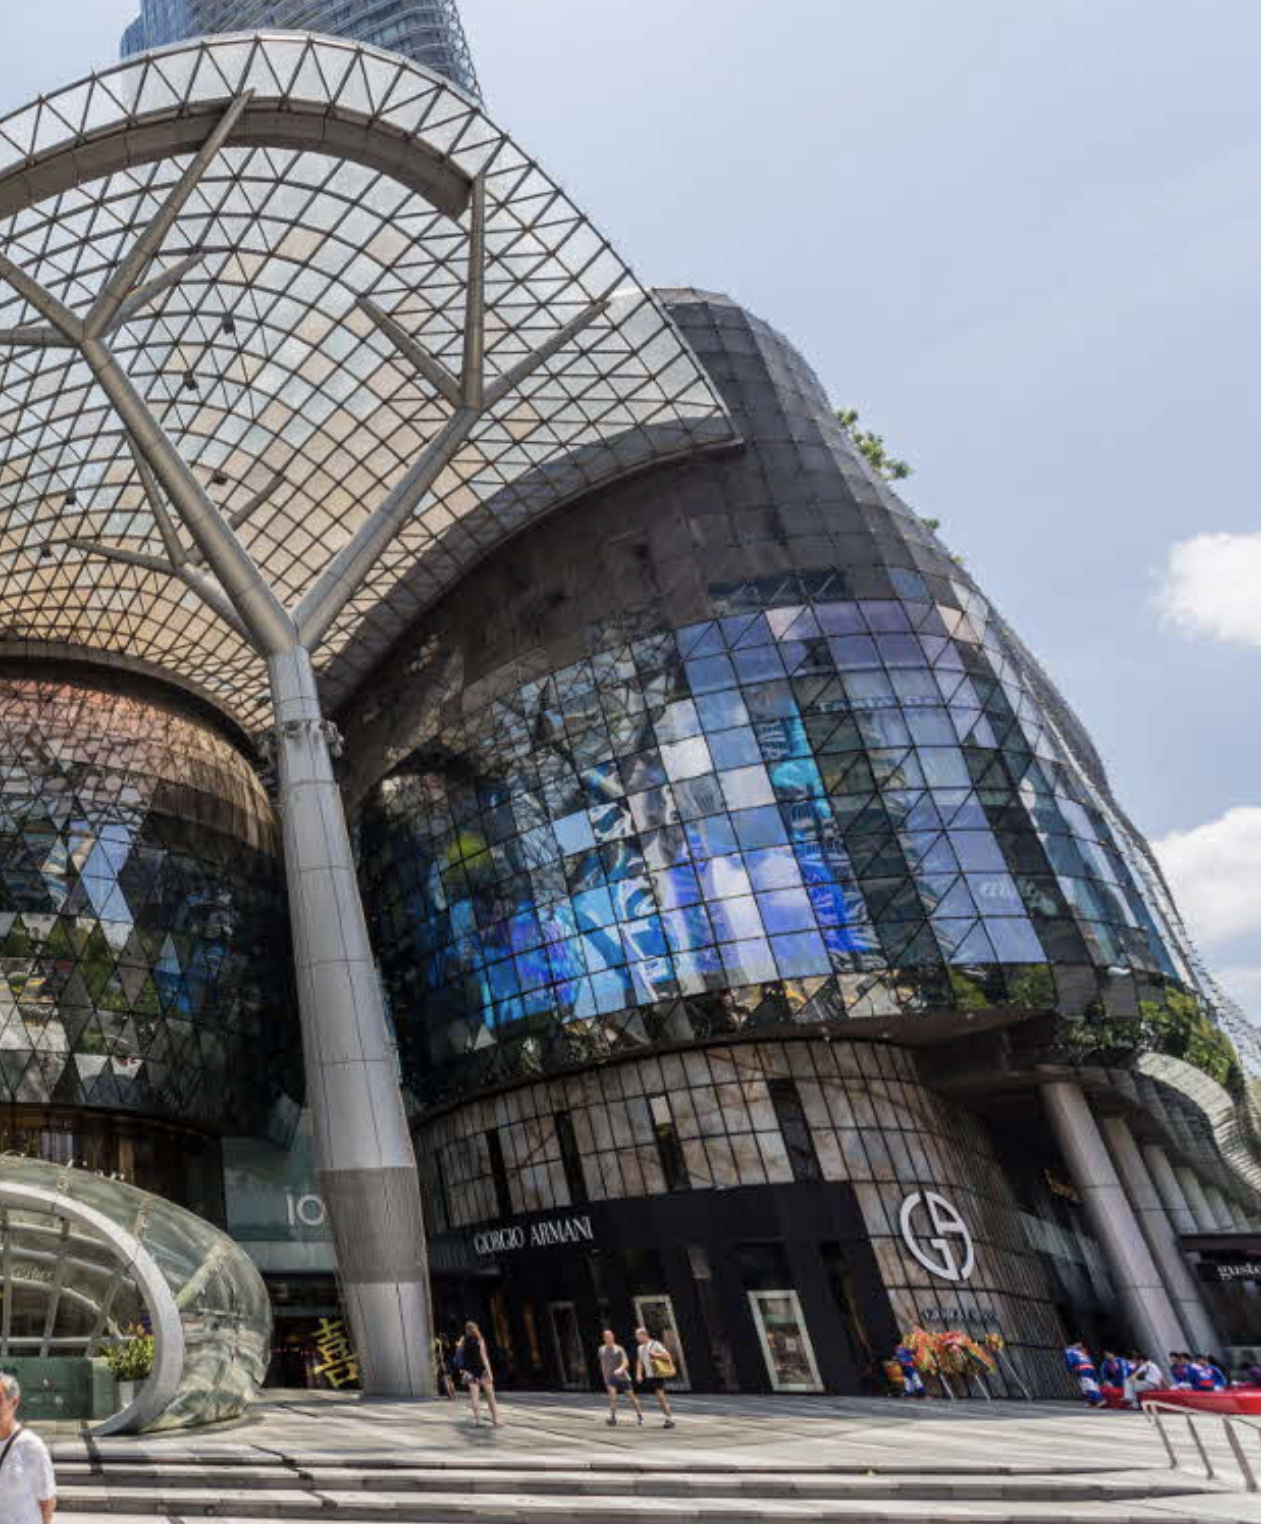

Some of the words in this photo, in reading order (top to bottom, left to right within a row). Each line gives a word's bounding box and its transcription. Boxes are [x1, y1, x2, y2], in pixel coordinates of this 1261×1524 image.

[286, 1193, 326, 1226] IO
[473, 1226, 525, 1254] GIORGIO
[531, 1216, 594, 1247] ARMANI
